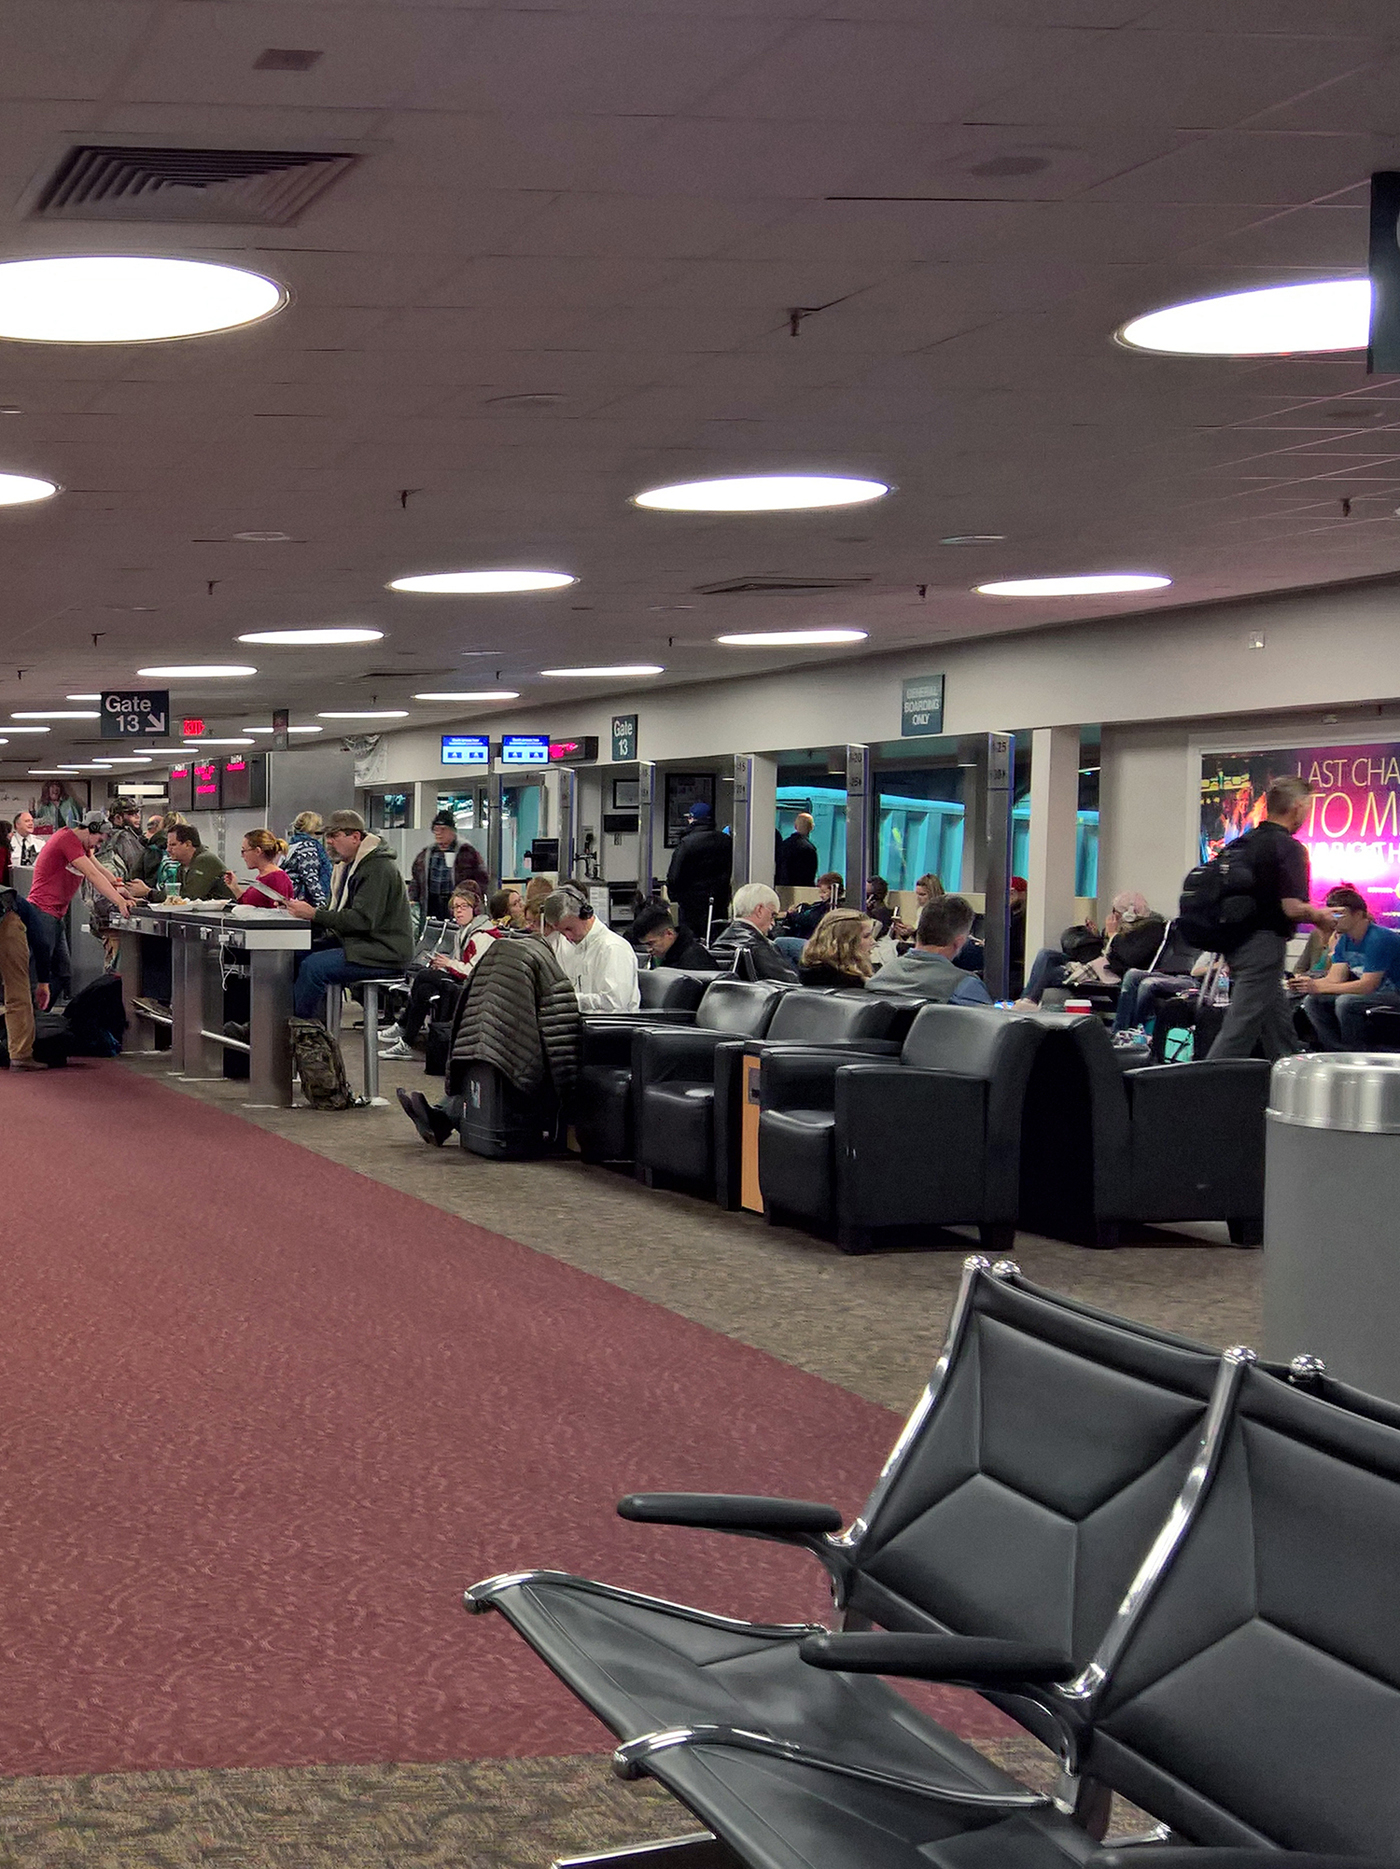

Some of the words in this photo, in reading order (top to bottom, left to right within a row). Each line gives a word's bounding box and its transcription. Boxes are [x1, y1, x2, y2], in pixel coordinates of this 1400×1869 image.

[105, 695, 152, 712] Gate
[904, 699, 940, 713] BOARDING
[116, 714, 140, 732] 13
[912, 713, 930, 725] ONLY
[613, 720, 633, 737] Gate
[618, 739, 629, 756] 13
[1351, 756, 1400, 787] CHA
[1308, 792, 1353, 838] TO
